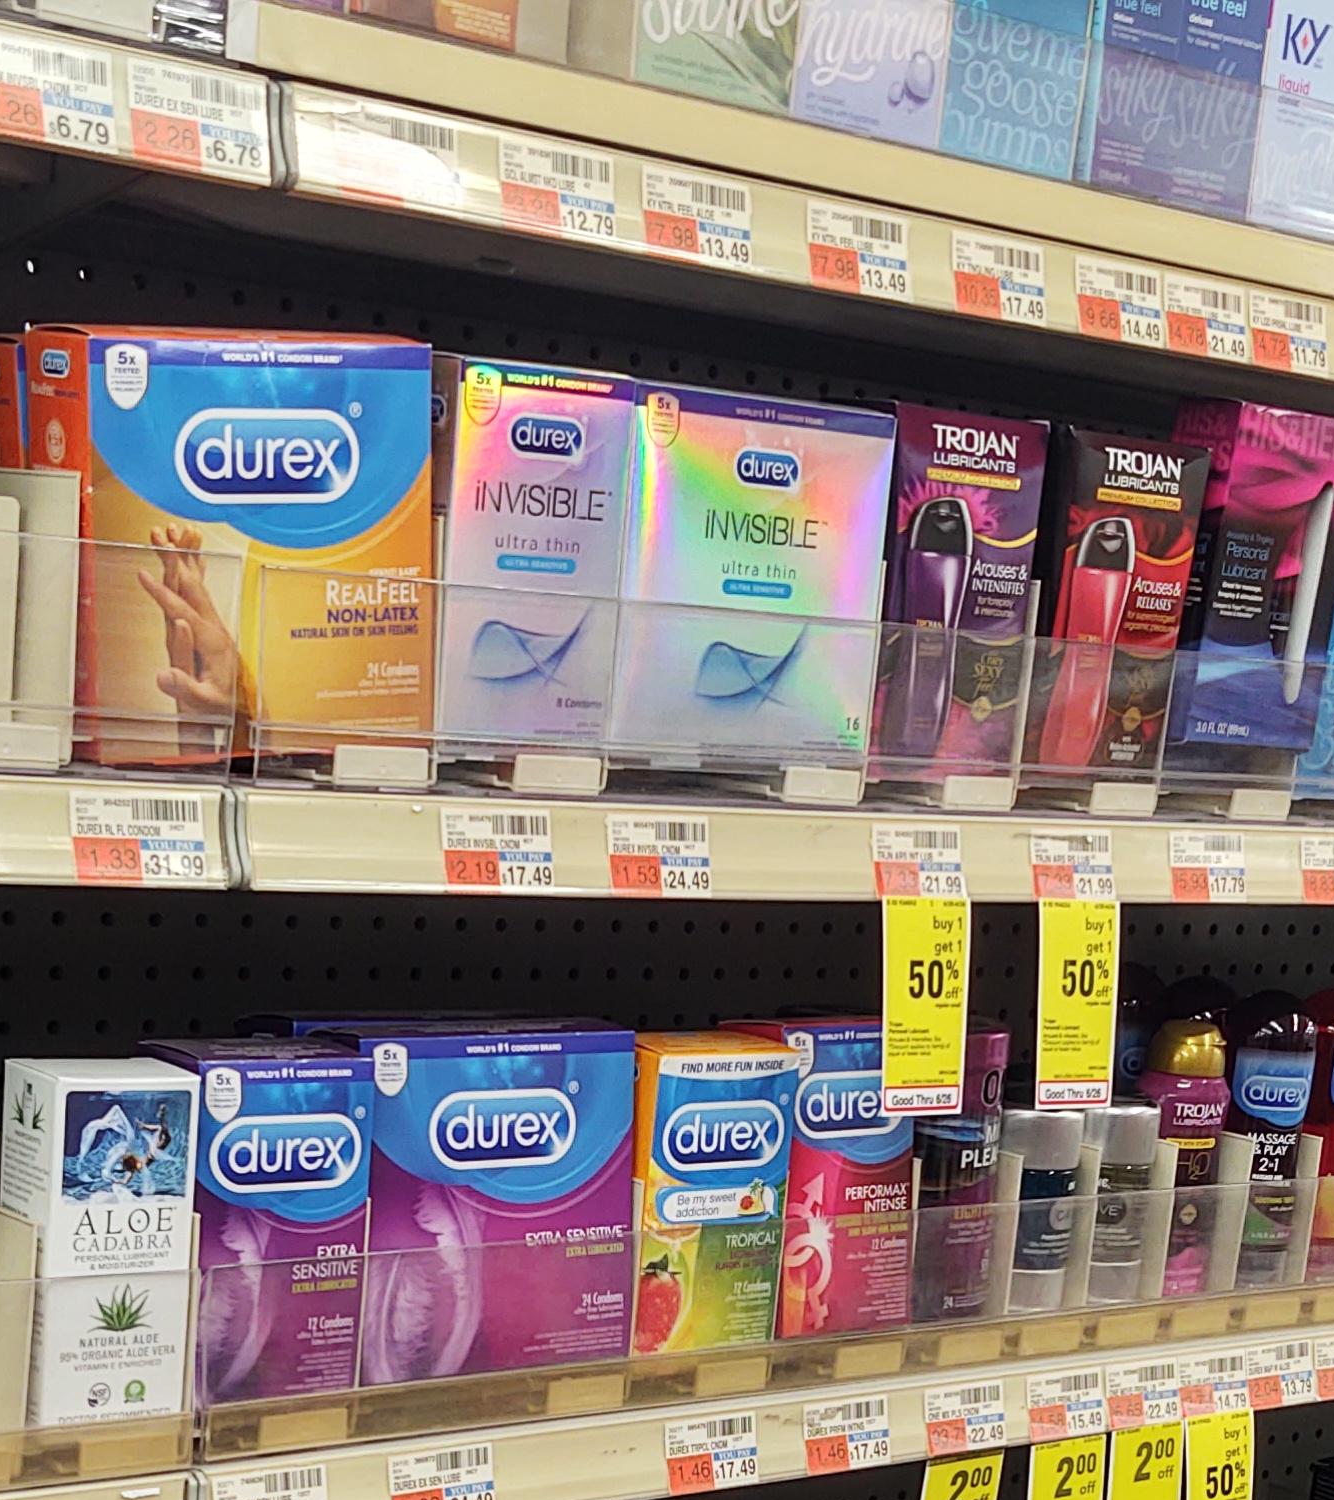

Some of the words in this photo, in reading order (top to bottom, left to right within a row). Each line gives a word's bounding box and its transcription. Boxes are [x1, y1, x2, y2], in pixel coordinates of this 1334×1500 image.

[1278, 73, 1309, 96] liquid
[515, 421, 581, 451] durex
[933, 425, 1017, 459] TROJAN
[195, 424, 338, 482] durex
[933, 452, 1016, 474] LUBRICANTS
[495, 534, 539, 551] ultra
[545, 537, 581, 554] thin
[327, 607, 419, 624] NON-LATEX
[846, 716, 859, 731] 16
[501, 865, 552, 886] $17.49
[681, 1062, 704, 1073] FIND
[706, 1061, 733, 1072] MORE
[735, 1061, 753, 1071] FUN
[755, 1059, 784, 1070] INSIDE
[1250, 1081, 1307, 1105] durex
[676, 1114, 771, 1155] durex
[227, 1130, 348, 1175] durex
[845, 1184, 907, 1200] PERFORMAX
[676, 1206, 719, 1218] addiction
[864, 1198, 907, 1212] INTENSE
[74, 1206, 174, 1237] ALOE
[73, 1233, 172, 1253] CADABRA
[726, 1232, 777, 1248] TROPICAL
[318, 1245, 357, 1260] EXTRA
[292, 1261, 358, 1279] SENSITIVE
